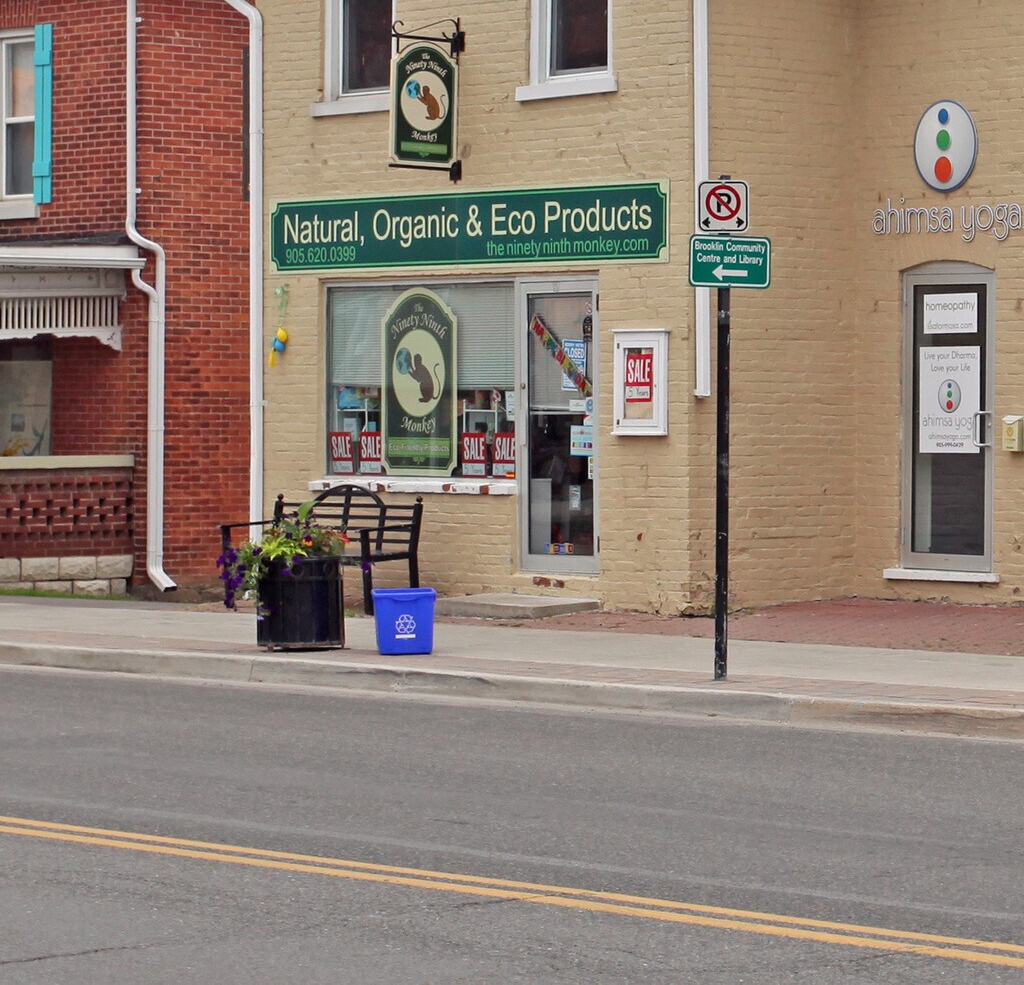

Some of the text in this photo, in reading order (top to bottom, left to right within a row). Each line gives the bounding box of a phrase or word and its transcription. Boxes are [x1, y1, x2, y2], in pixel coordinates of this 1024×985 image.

[411, 130, 438, 142] Monkey
[283, 199, 653, 247] Natural, Organic & Eco Products
[872, 197, 1023, 242] ahimsa yoga
[285, 245, 356, 264] 905.620.0399
[695, 240, 766, 254] Brooklin Community
[697, 253, 764, 266] Centre and Library
[413, 303, 424, 312] The
[926, 300, 976, 312] homeopathy
[391, 313, 448, 340] Ninety Ninth
[924, 351, 936, 360] Live
[937, 353, 950, 361] your
[628, 358, 651, 383] SALE
[931, 363, 971, 373] Love your Life
[401, 416, 436, 434] Monkey
[922, 413, 974, 430] ahimsa yog
[331, 436, 352, 458] SALE
[361, 436, 381, 458] SALE
[463, 437, 485, 460] SALE
[495, 437, 515, 460] SALE
